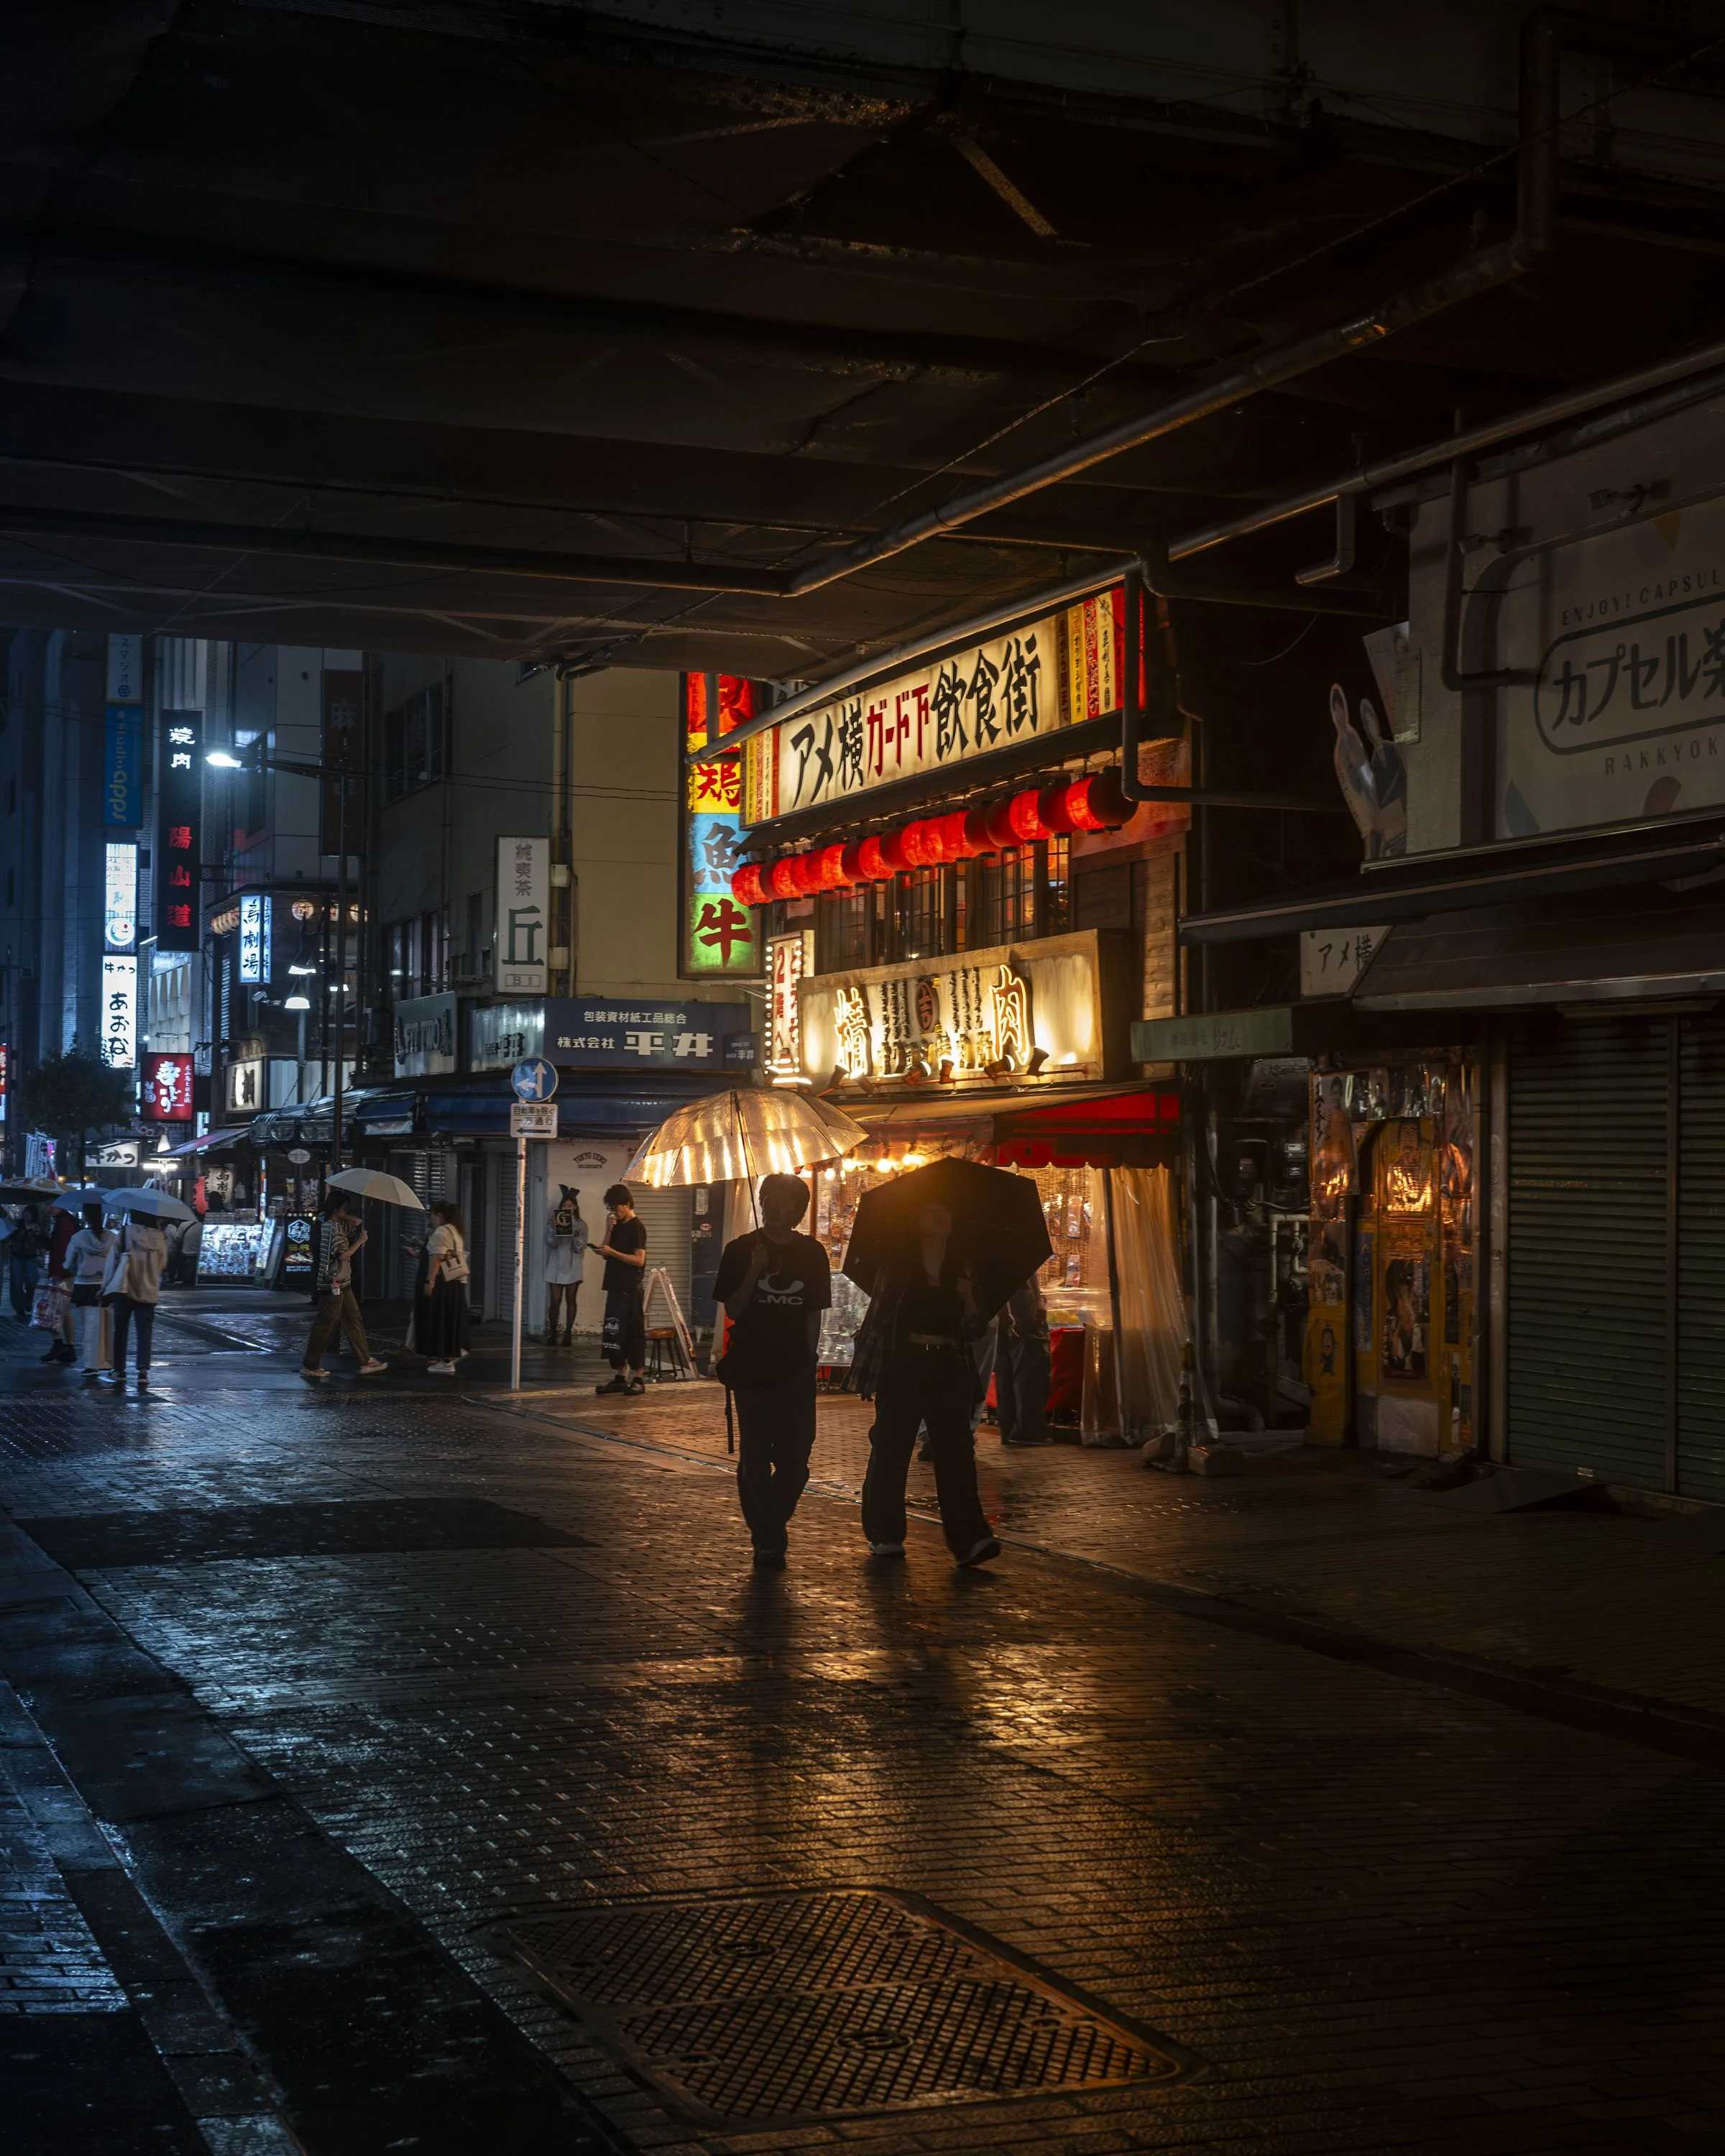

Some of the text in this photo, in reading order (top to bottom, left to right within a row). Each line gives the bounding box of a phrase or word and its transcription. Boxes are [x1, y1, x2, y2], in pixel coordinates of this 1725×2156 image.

[1563, 594, 1630, 625] ENJOY!
[167, 826, 193, 927] 陽山道
[104, 962, 135, 974] 牛かつ
[109, 992, 130, 1054] あおな
[584, 1010, 687, 1025] 包装資材紙工品総合
[557, 1031, 714, 1057] 株式会社 平井
[513, 1106, 556, 1115] 自転車を除く
[513, 1117, 554, 1126] 一方通行
